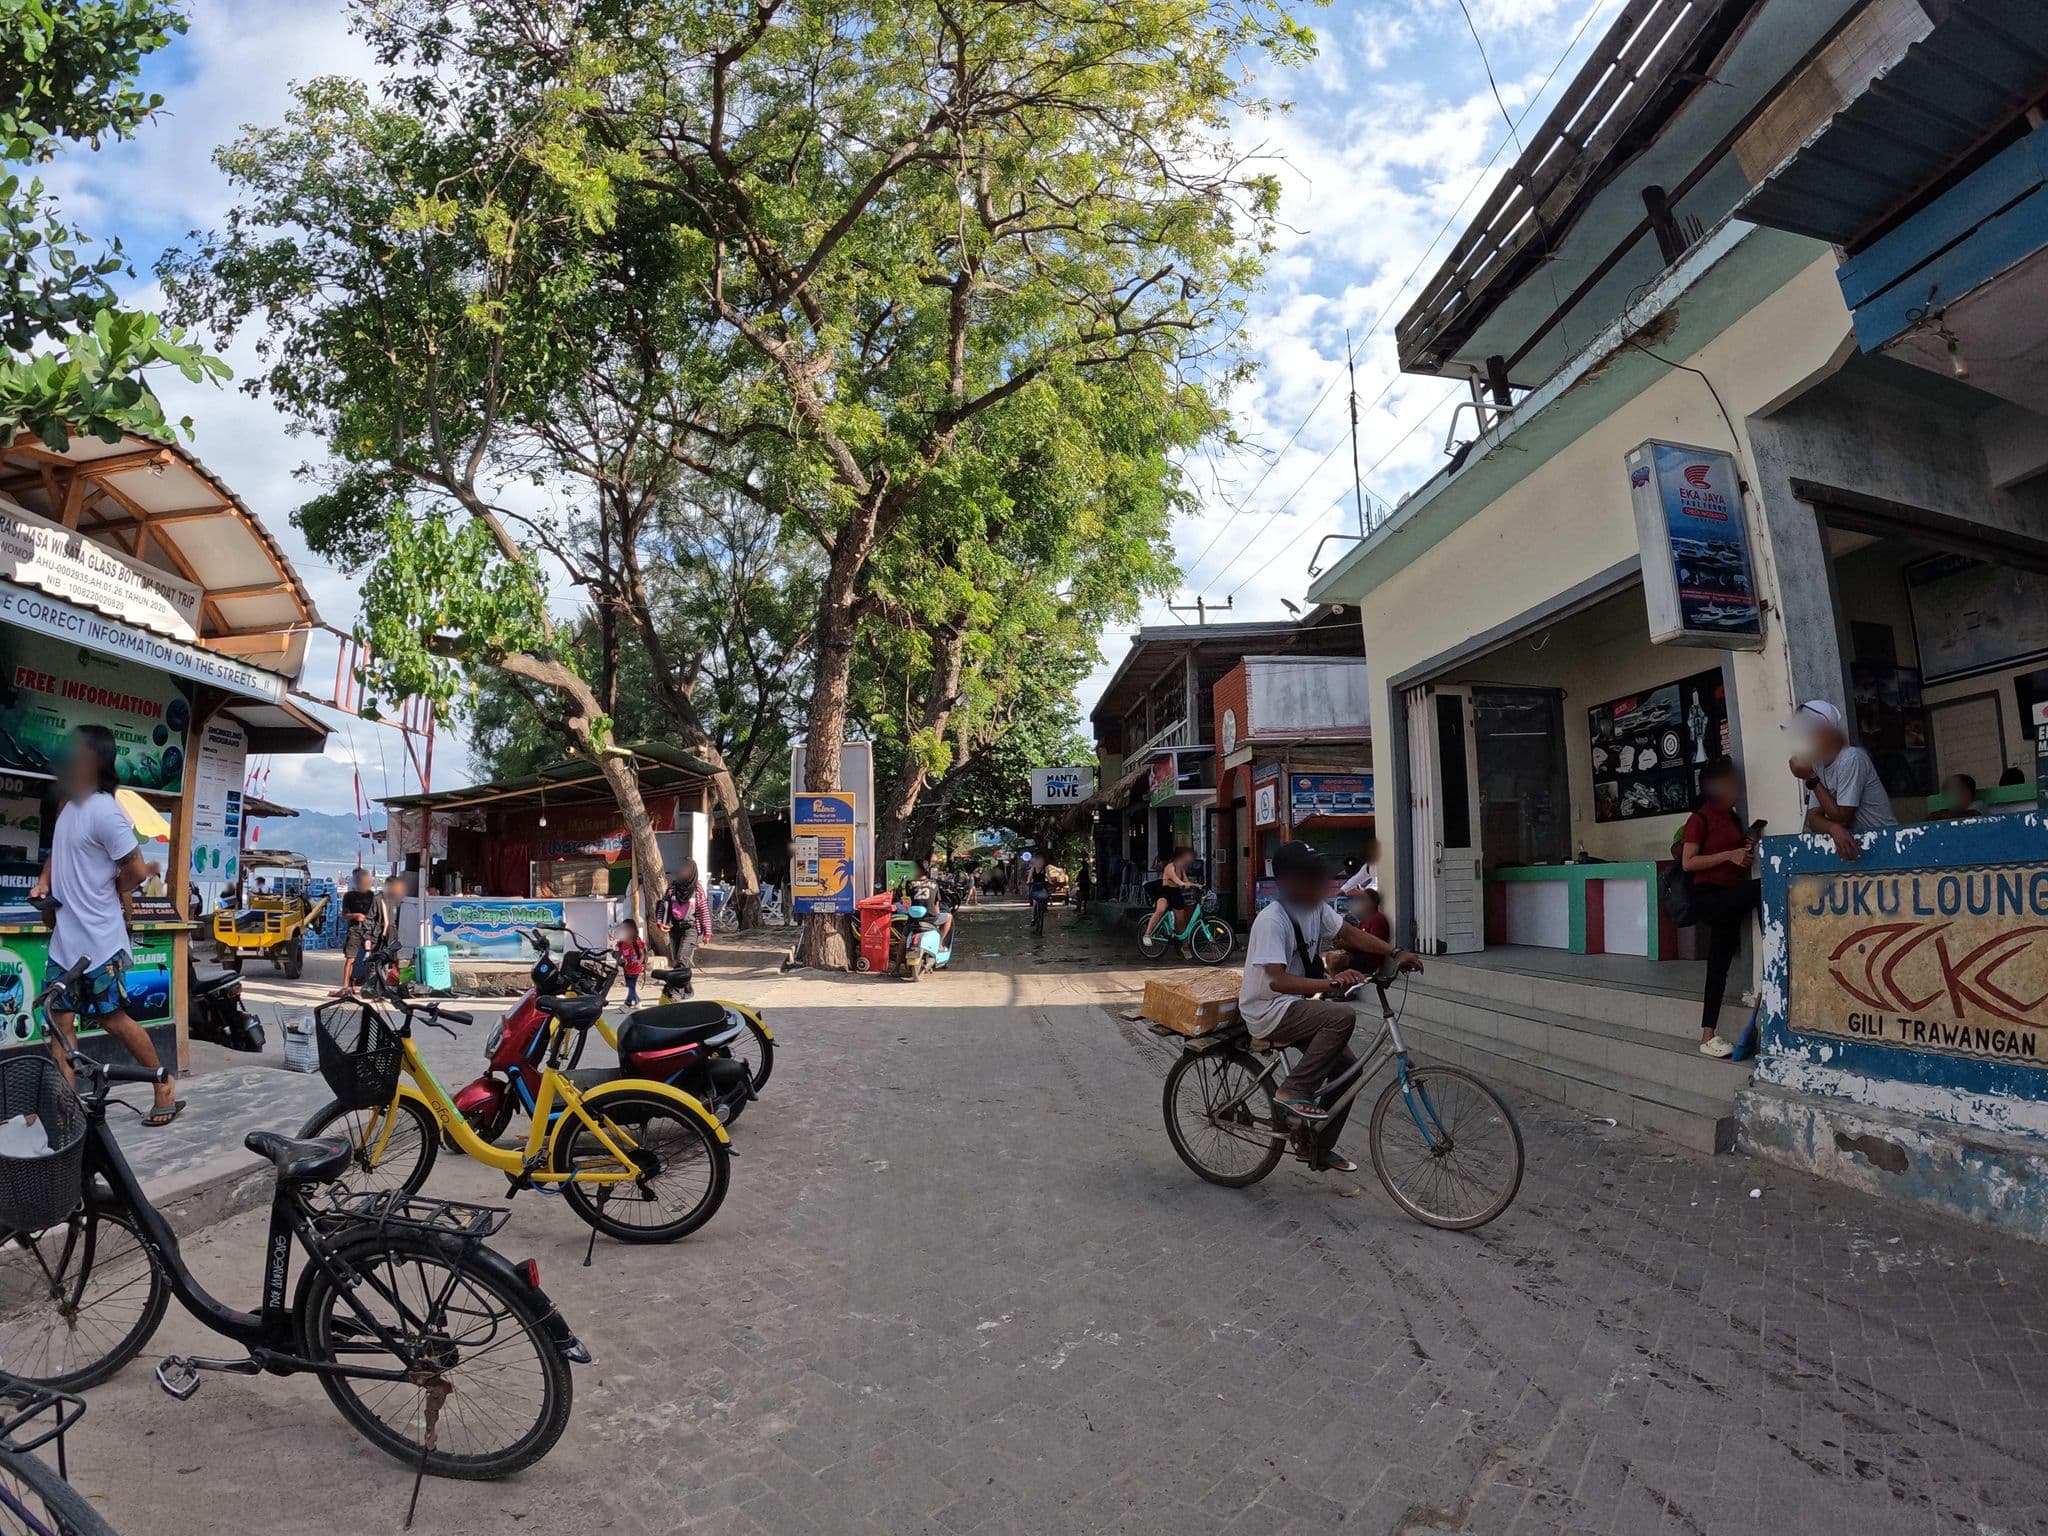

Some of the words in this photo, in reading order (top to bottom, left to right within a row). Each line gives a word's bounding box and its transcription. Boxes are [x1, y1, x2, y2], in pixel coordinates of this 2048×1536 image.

[1680, 487, 1701, 501] EKA
[1703, 492, 1726, 506] JAYA
[1, 540, 34, 562] NOMOR
[150, 600, 166, 613] 2020
[23, 527, 49, 551] JASA
[51, 537, 86, 566] WISATA
[88, 554, 117, 578] GLASS
[118, 567, 153, 592] BOTTOM
[155, 581, 176, 602] BOAT
[177, 591, 195, 609] TRIP
[47, 575, 61, 587] NIB
[0, 594, 13, 610] E
[17, 598, 86, 633] CORRECT
[88, 621, 172, 662] INFORMATION
[175, 651, 193, 668] ON
[195, 657, 215, 676] THE
[15, 666, 57, 695] FREE
[61, 679, 163, 719] INFORMATION
[112, 728, 148, 745] RKELING
[1046, 774, 1078, 782] MANTA
[1047, 784, 1079, 798] DIVE
[914, 887, 930, 900] 23
[1807, 877, 1900, 917] JUKU
[1911, 870, 2048, 917] LOUNG
[442, 906, 459, 922] Es
[460, 905, 510, 927] Kelapa
[511, 905, 554, 922] Muda
[1848, 1012, 1884, 1036] GILI
[1897, 1018, 2036, 1057] TRAWANGAN
[431, 1100, 450, 1124] ofo
